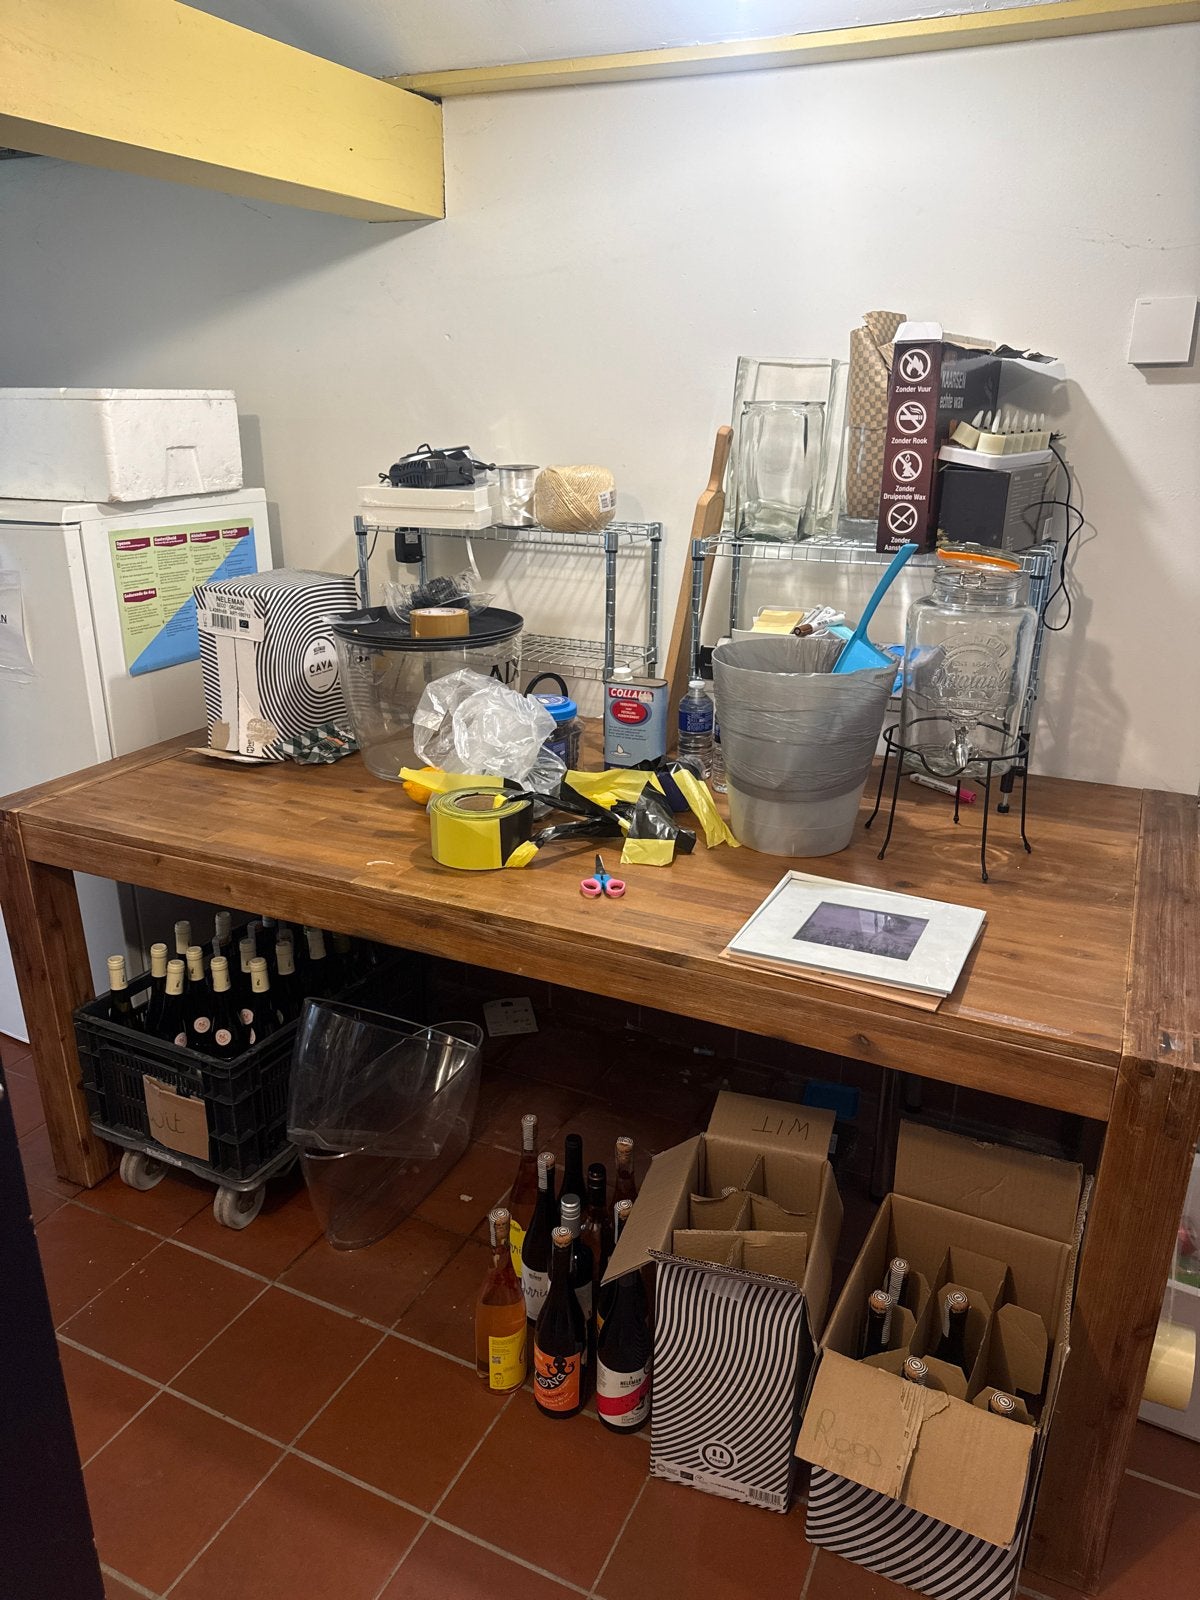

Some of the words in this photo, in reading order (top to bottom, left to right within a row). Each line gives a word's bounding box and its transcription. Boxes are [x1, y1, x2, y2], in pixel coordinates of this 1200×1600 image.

[895, 385, 917, 393] Zonder
[917, 385, 932, 393] Vuur
[895, 484, 916, 492] Zonder
[883, 493, 913, 501] Druipende
[216, 595, 245, 606] NELEMAN
[309, 659, 333, 674] CAVA
[752, 1116, 810, 1141] WIT
